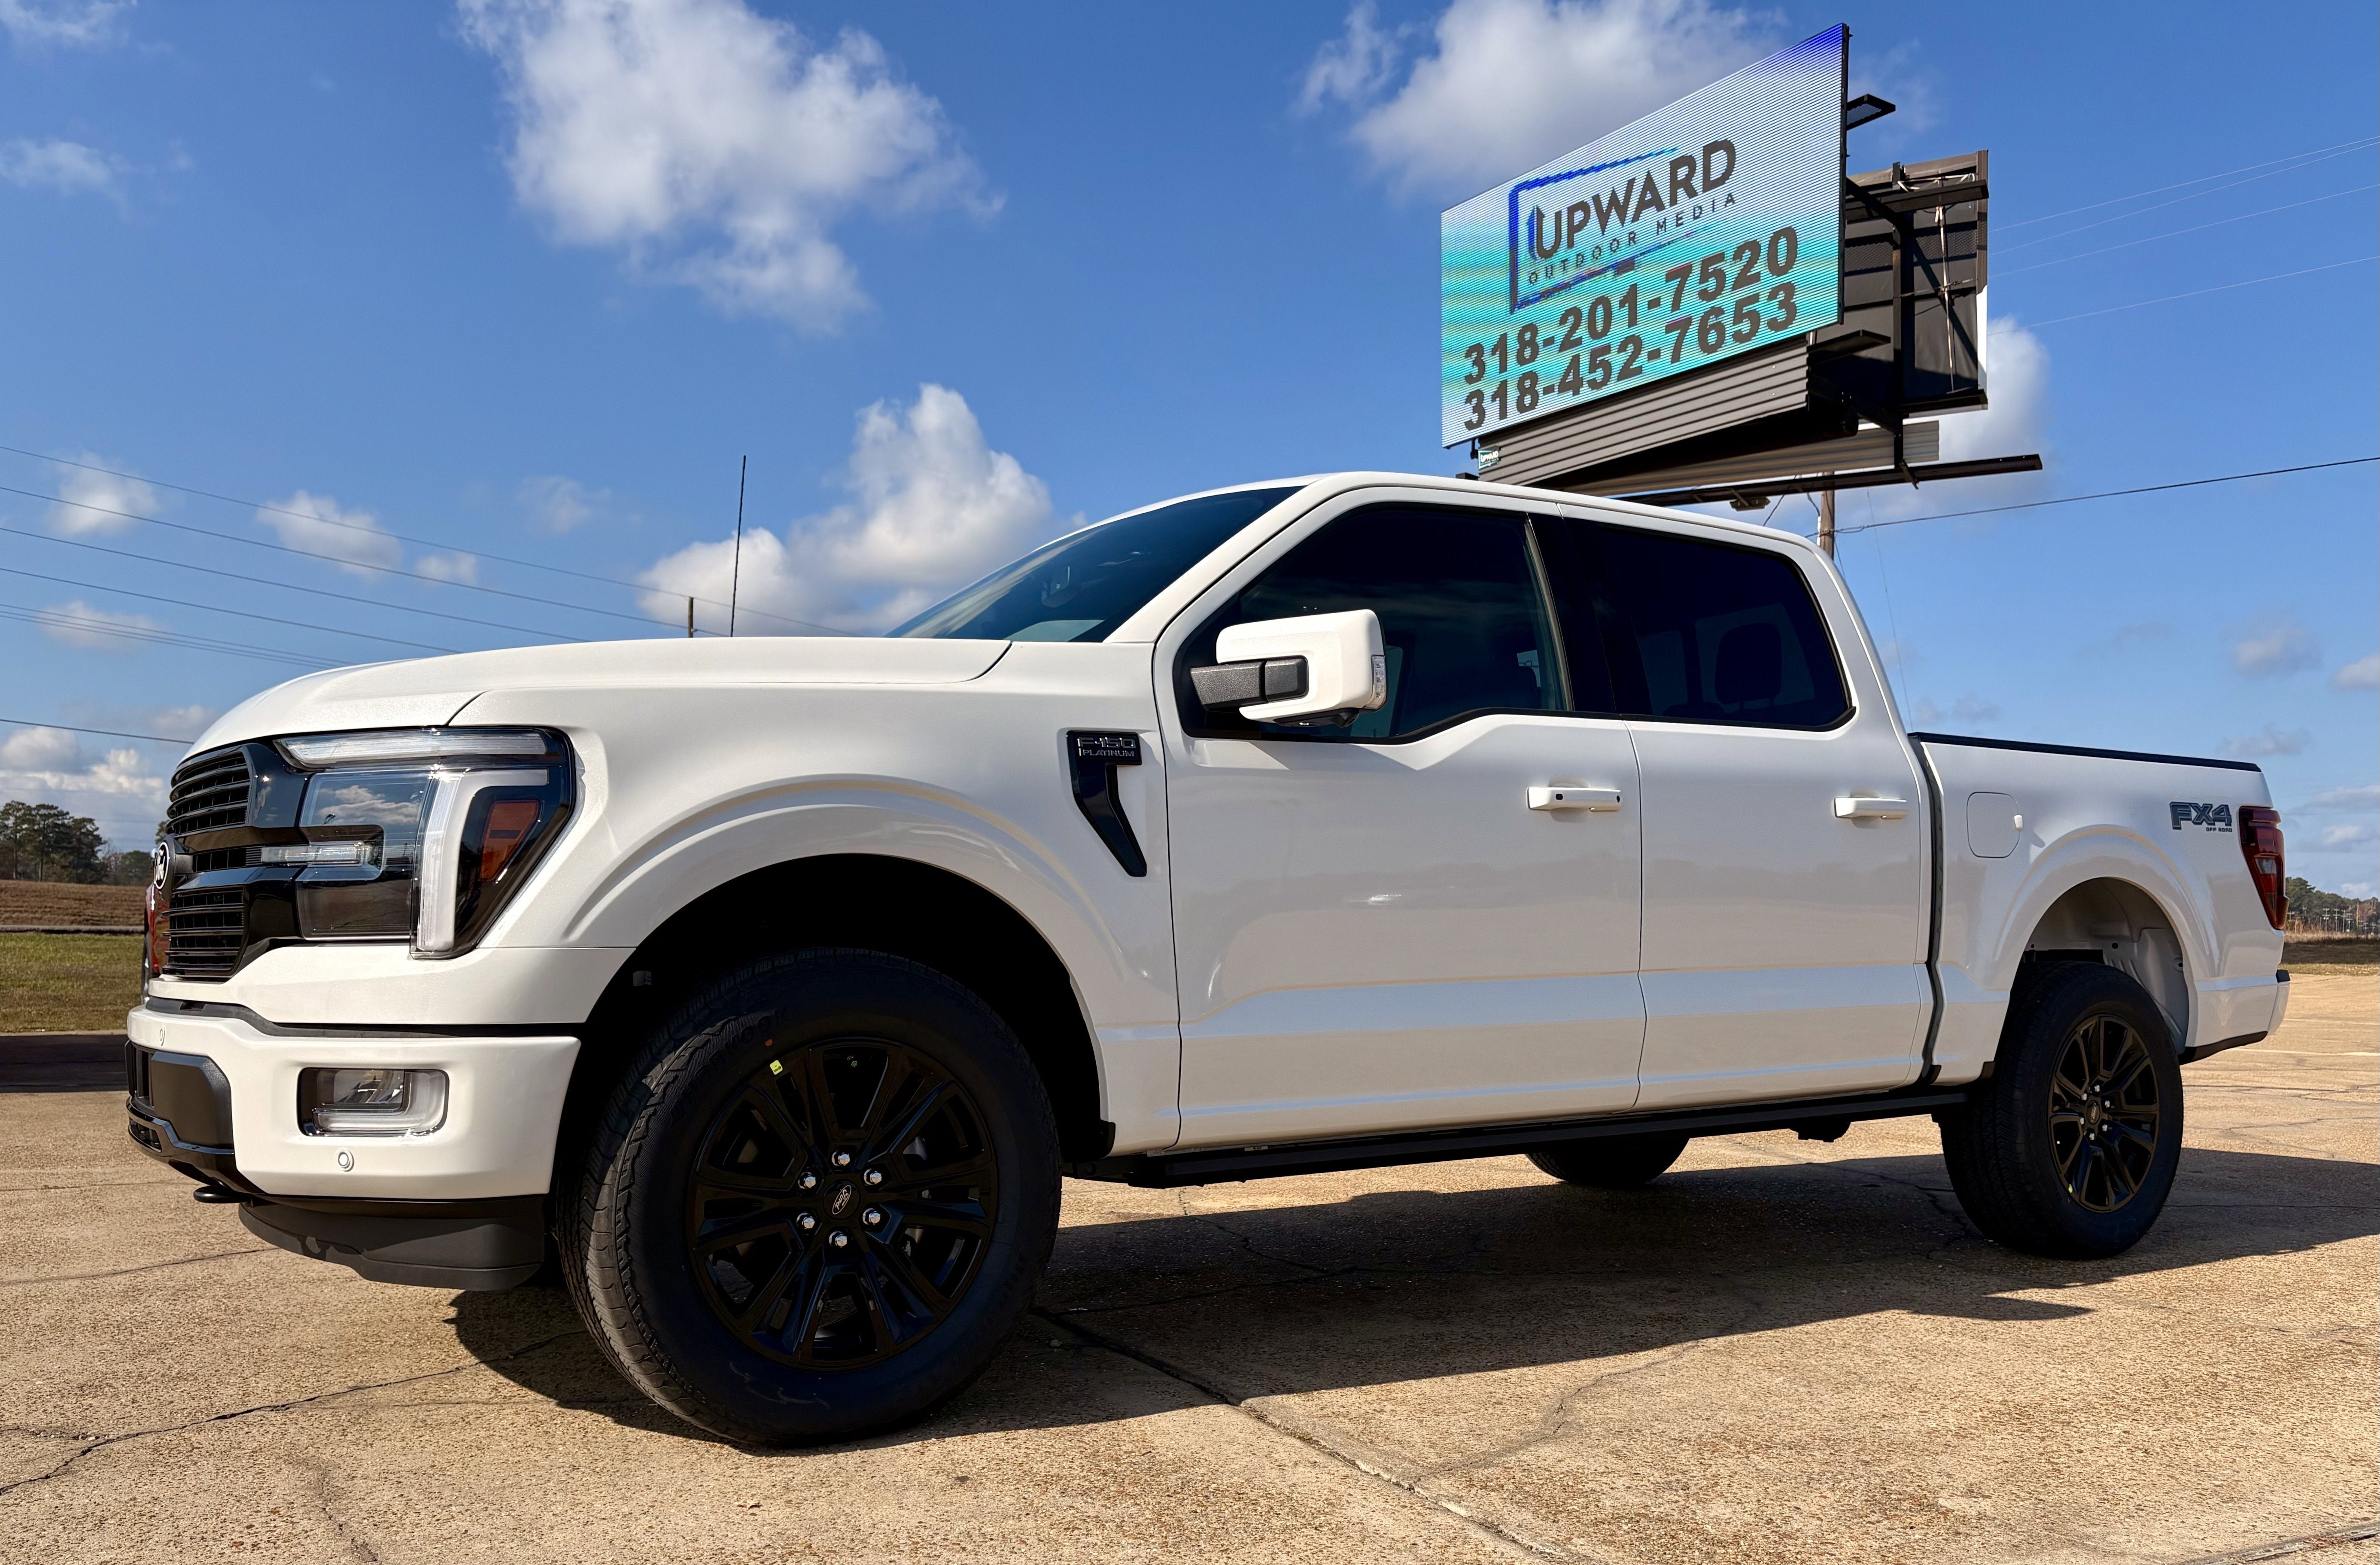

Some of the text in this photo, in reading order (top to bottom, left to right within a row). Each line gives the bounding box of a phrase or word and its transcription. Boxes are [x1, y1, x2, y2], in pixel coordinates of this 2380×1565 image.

[1529, 192, 1736, 285] OUTDOOR MEDIA
[1535, 138, 1736, 259] UPWARD
[1464, 226, 1798, 385] 318-201-7520
[1464, 281, 1798, 431] 318-452-7653
[1077, 737, 1136, 749] F-150
[2169, 801, 2232, 830] FX4
[834, 1189, 849, 1210] Ford
